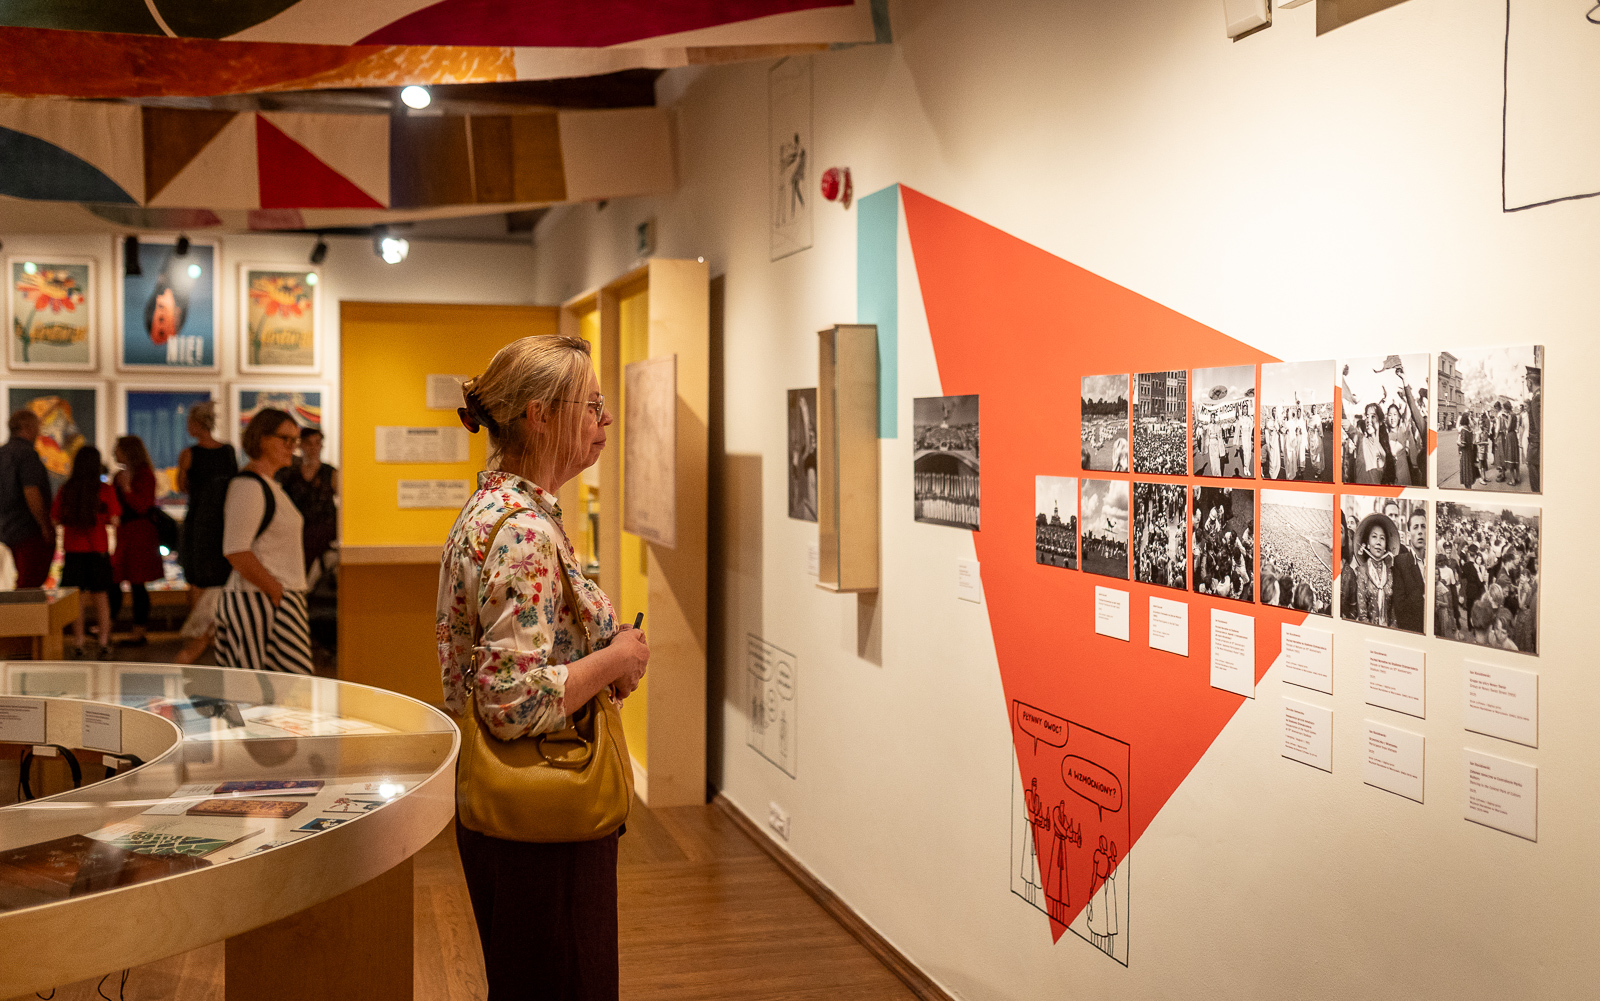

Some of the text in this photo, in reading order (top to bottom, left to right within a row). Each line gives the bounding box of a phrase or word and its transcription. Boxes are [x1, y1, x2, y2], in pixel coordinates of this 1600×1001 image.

[166, 334, 204, 364] NIE!
[1044, 720, 1062, 735] OWOC?
[1068, 768, 1072, 777] A
